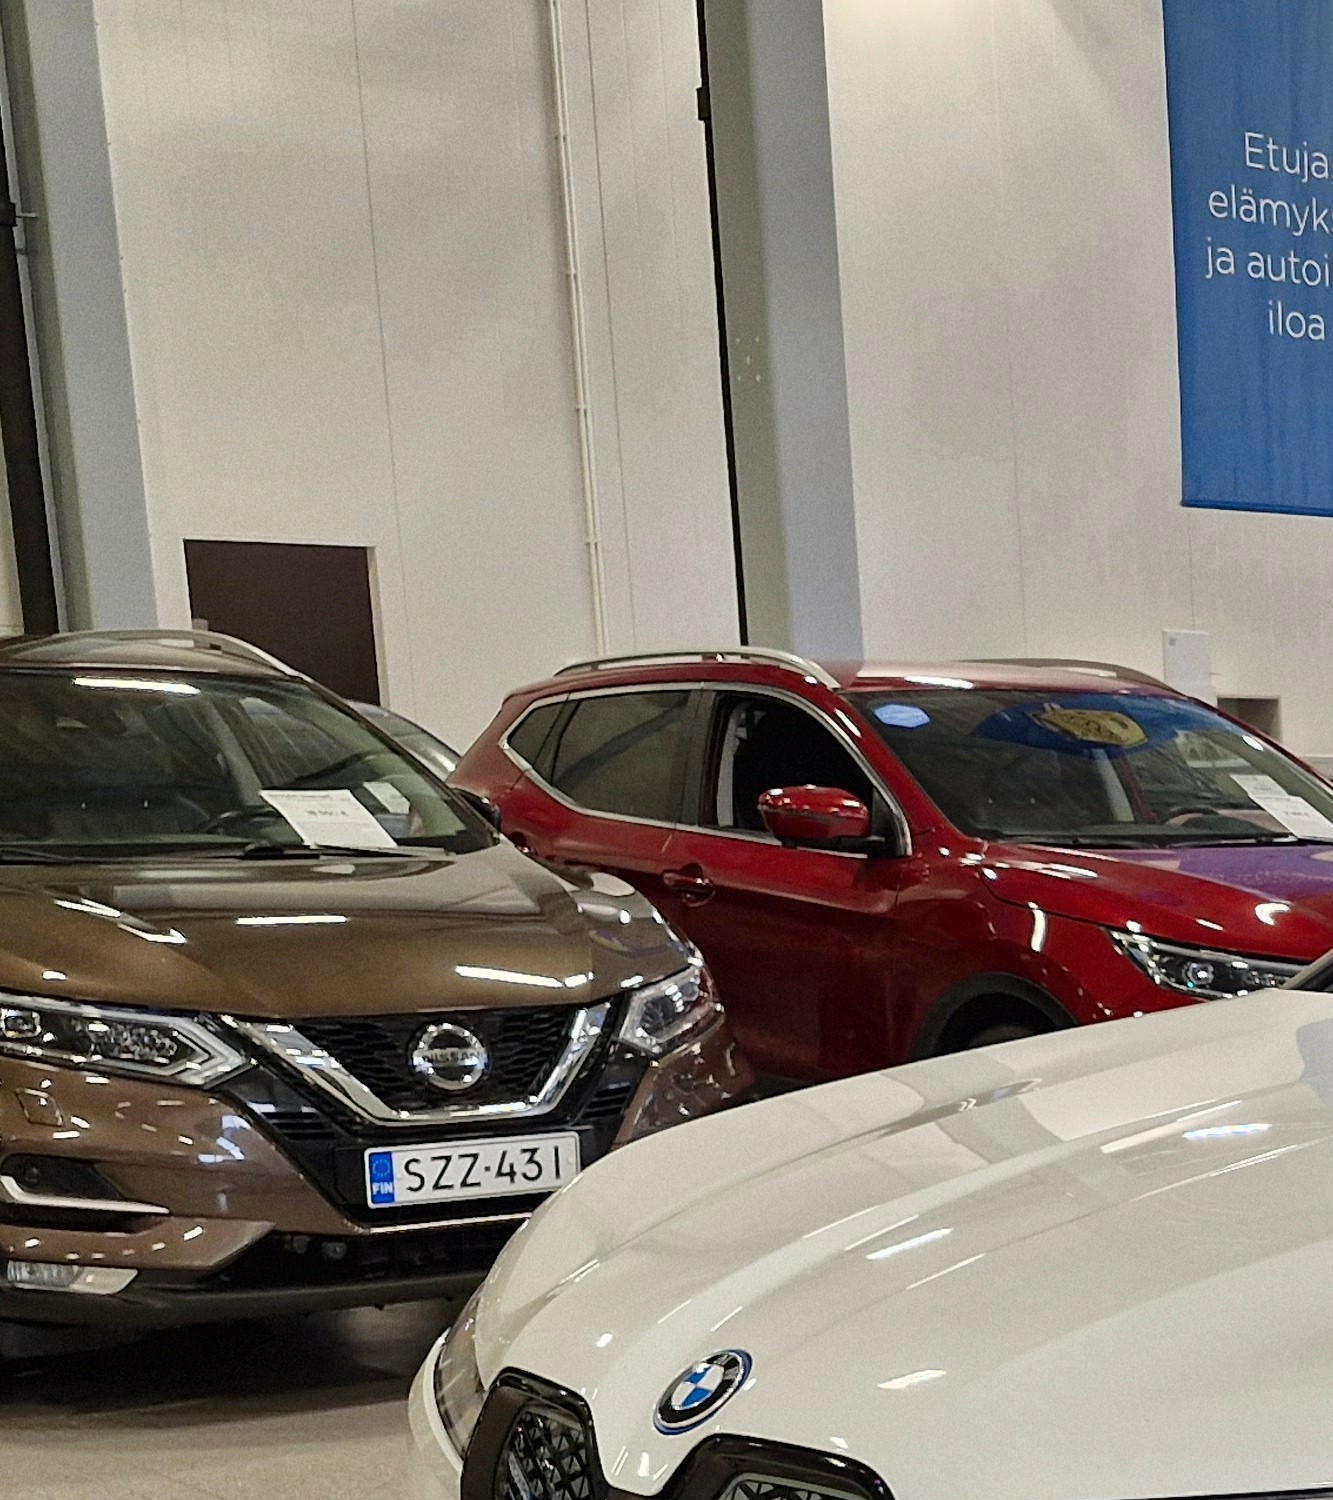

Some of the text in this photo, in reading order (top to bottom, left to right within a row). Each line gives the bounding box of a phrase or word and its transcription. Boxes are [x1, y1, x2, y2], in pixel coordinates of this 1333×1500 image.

[1205, 242, 1237, 281] ja
[1268, 302, 1327, 343] iloa
[422, 1051, 479, 1064] NISSAN
[372, 1182, 394, 1195] FIN
[404, 1146, 561, 1192] SZZ-431
